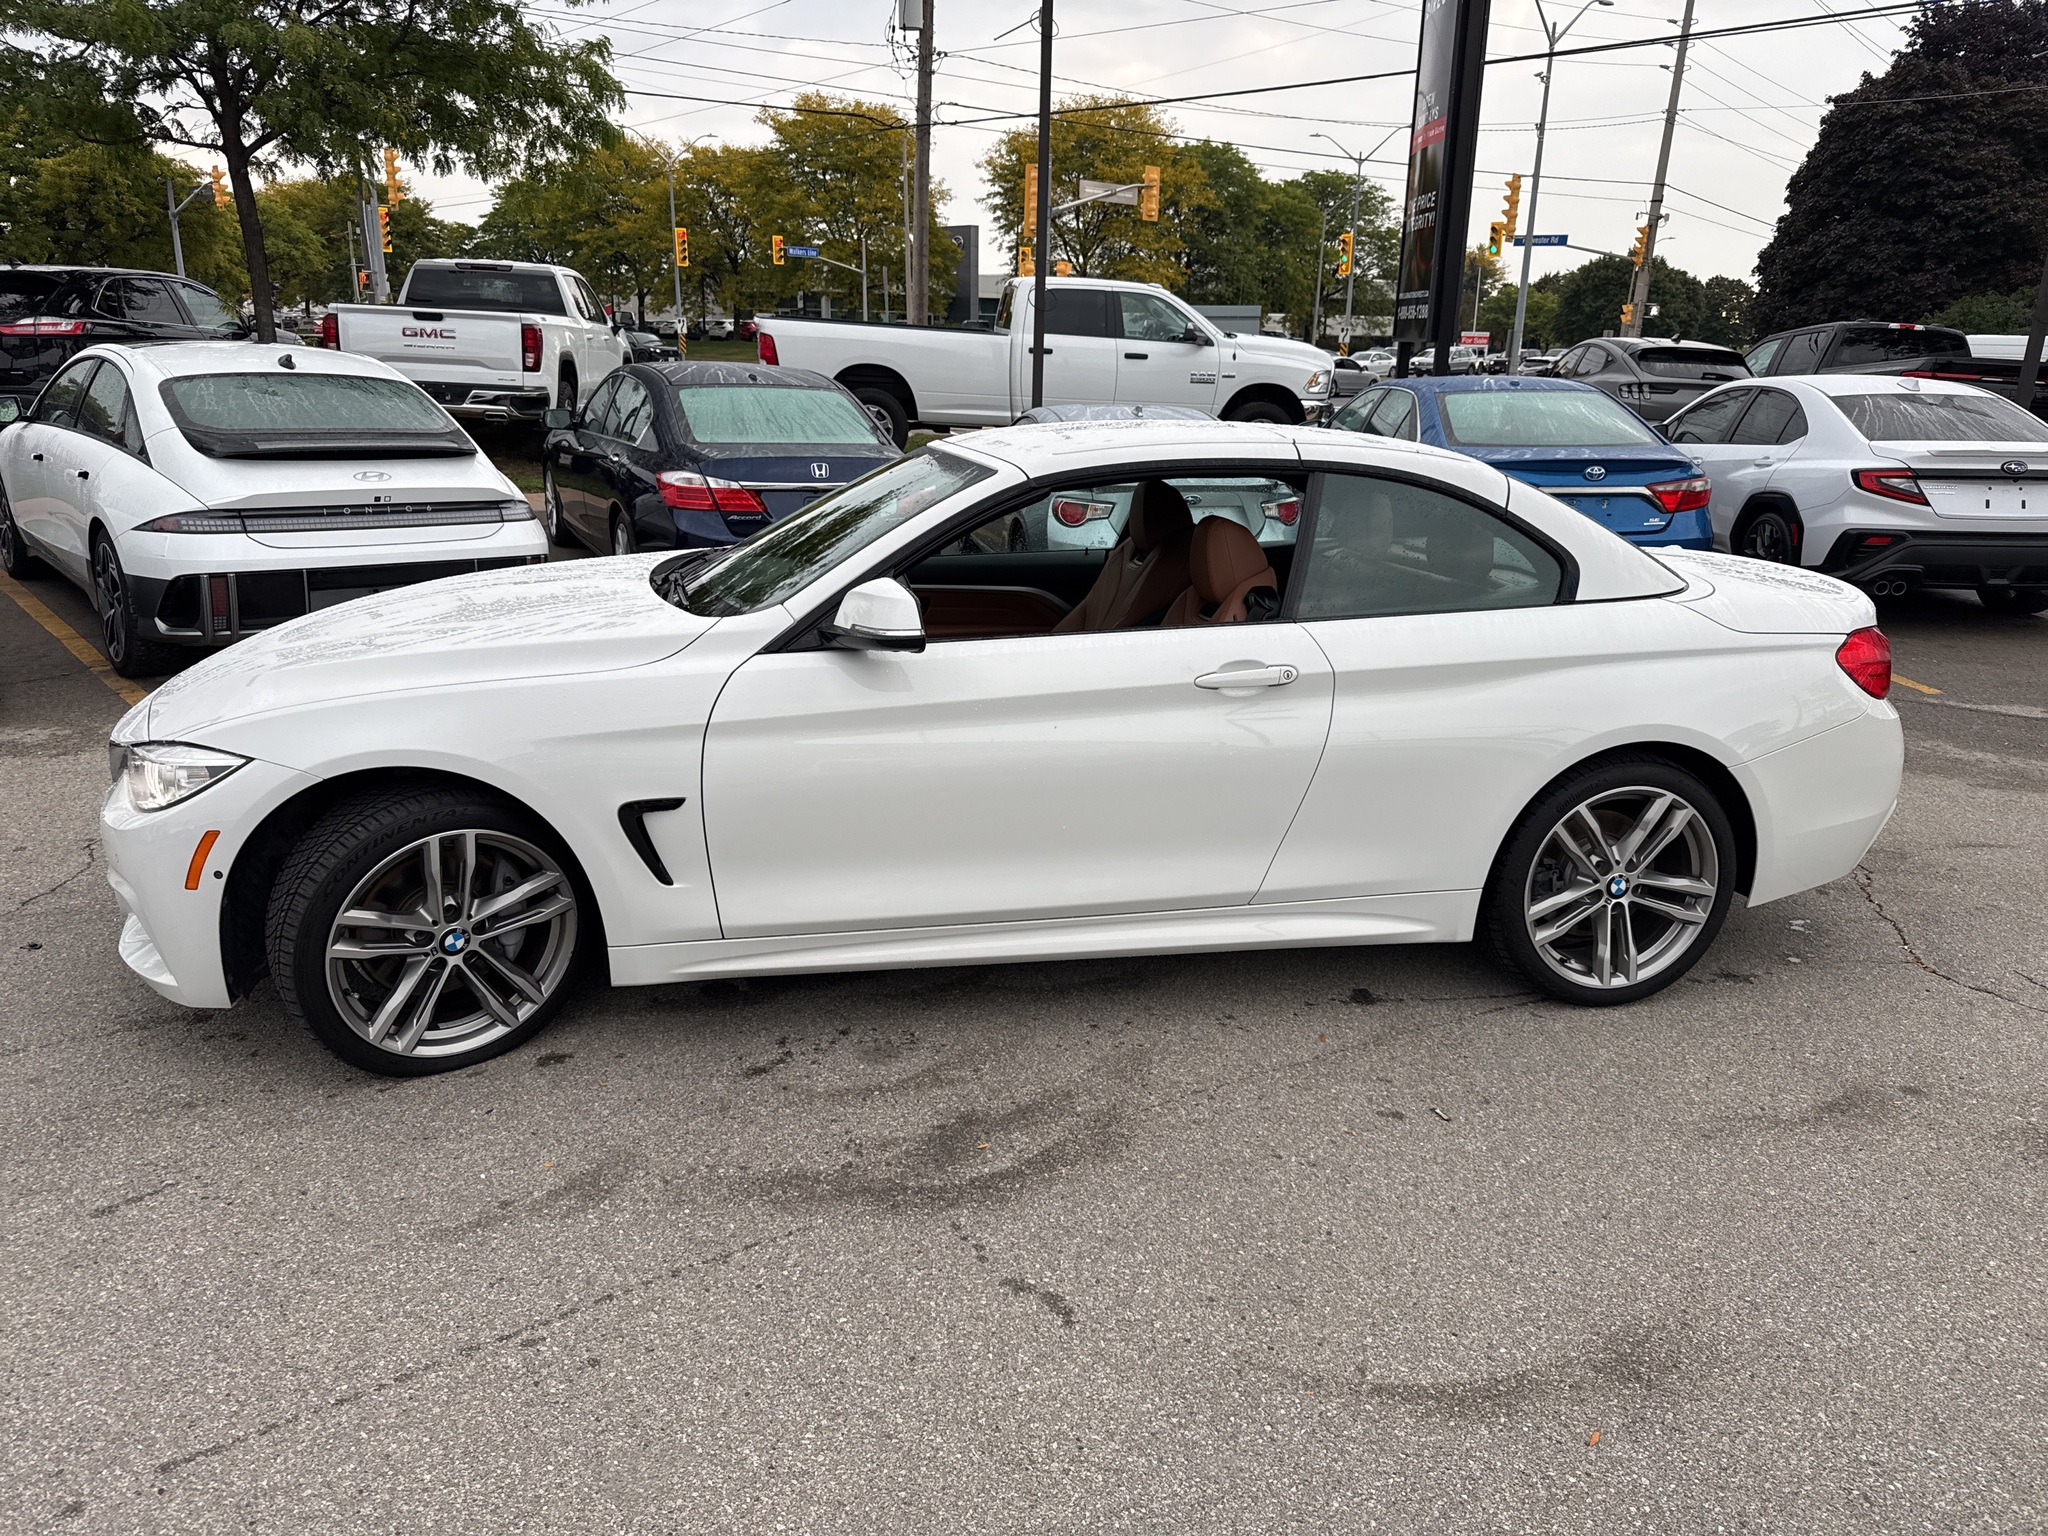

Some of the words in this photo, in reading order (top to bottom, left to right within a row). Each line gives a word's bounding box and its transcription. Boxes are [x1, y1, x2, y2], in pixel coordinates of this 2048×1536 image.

[1416, 190, 1437, 212] PRICE
[1550, 236, 1560, 244] Rd
[807, 248, 817, 257] Line
[402, 327, 457, 340] GMC
